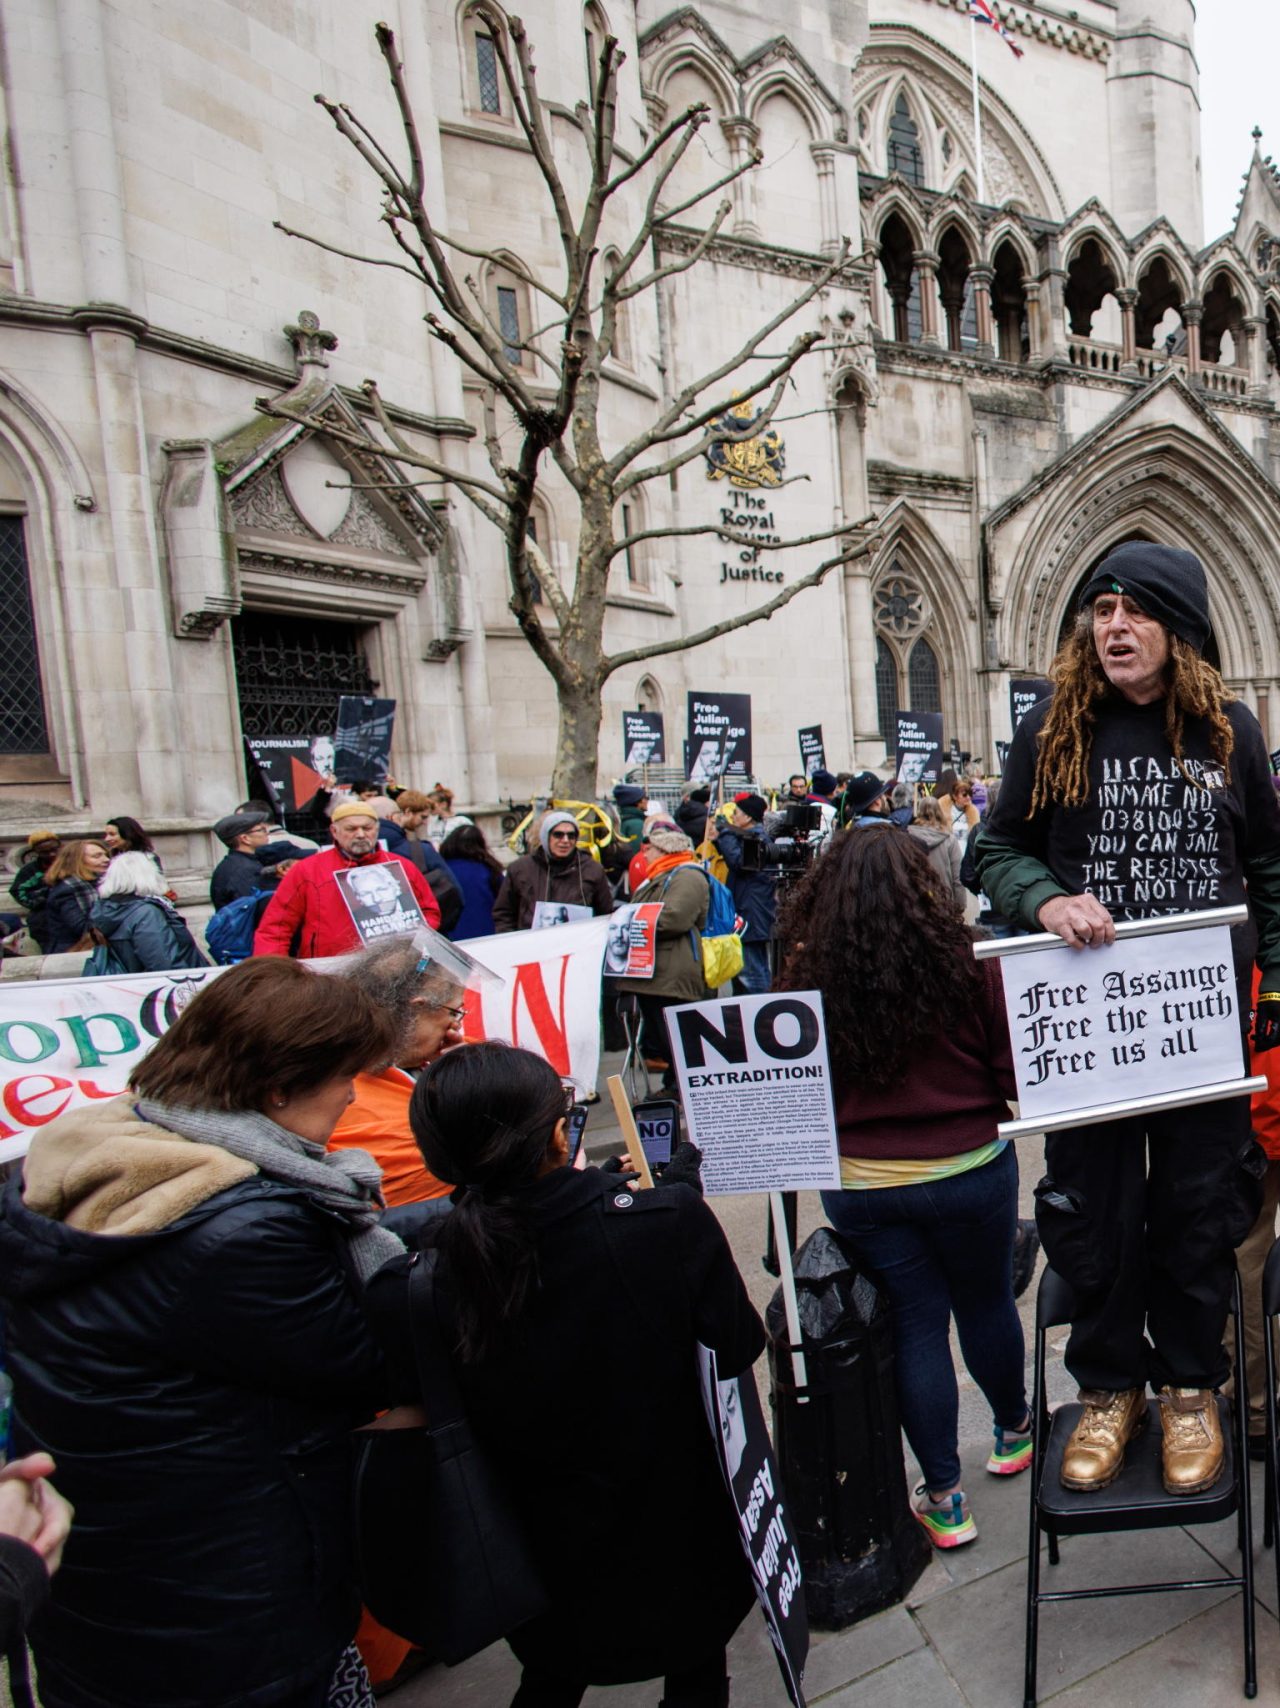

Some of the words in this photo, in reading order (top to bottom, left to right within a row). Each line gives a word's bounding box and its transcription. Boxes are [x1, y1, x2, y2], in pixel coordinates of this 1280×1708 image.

[728, 491, 767, 510] The
[719, 508, 775, 529] Royal
[740, 546, 762, 564] of
[720, 562, 784, 584] Justice
[1013, 692, 1036, 703] Free
[693, 702, 719, 713] Free
[626, 717, 644, 725] Free
[627, 724, 651, 732] Julian
[693, 713, 730, 725] Julian
[898, 719, 918, 729] Free
[627, 731, 661, 739] Assange
[694, 725, 746, 738] Assage
[898, 729, 926, 740] Julian
[249, 739, 309, 748] JOURNALISM
[898, 739, 939, 750] Assange
[1099, 783, 1175, 808] INMATE
[1183, 785, 1216, 812] NO.
[1087, 833, 1126, 856] YOU
[1135, 832, 1178, 853] CAN
[1185, 831, 1220, 853] JAIL
[1081, 860, 1120, 884] THE
[1130, 856, 1221, 879] RESISTER
[1134, 878, 1177, 902] NOT
[1186, 879, 1219, 900] THE
[399, 909, 418, 920] OFF
[1017, 981, 1088, 1019] Free
[1102, 963, 1229, 1001] Assange
[1022, 1015, 1092, 1053] Free
[1106, 1004, 1149, 1036] the
[1161, 989, 1233, 1025] truth
[675, 998, 820, 1069] NO
[1026, 1048, 1097, 1087] Free
[1110, 1038, 1146, 1066] us
[1160, 1027, 1199, 1058] all
[688, 1065, 824, 1088] EXTRADITION!
[638, 1121, 671, 1138] NO
[778, 1545, 802, 1618] Free
